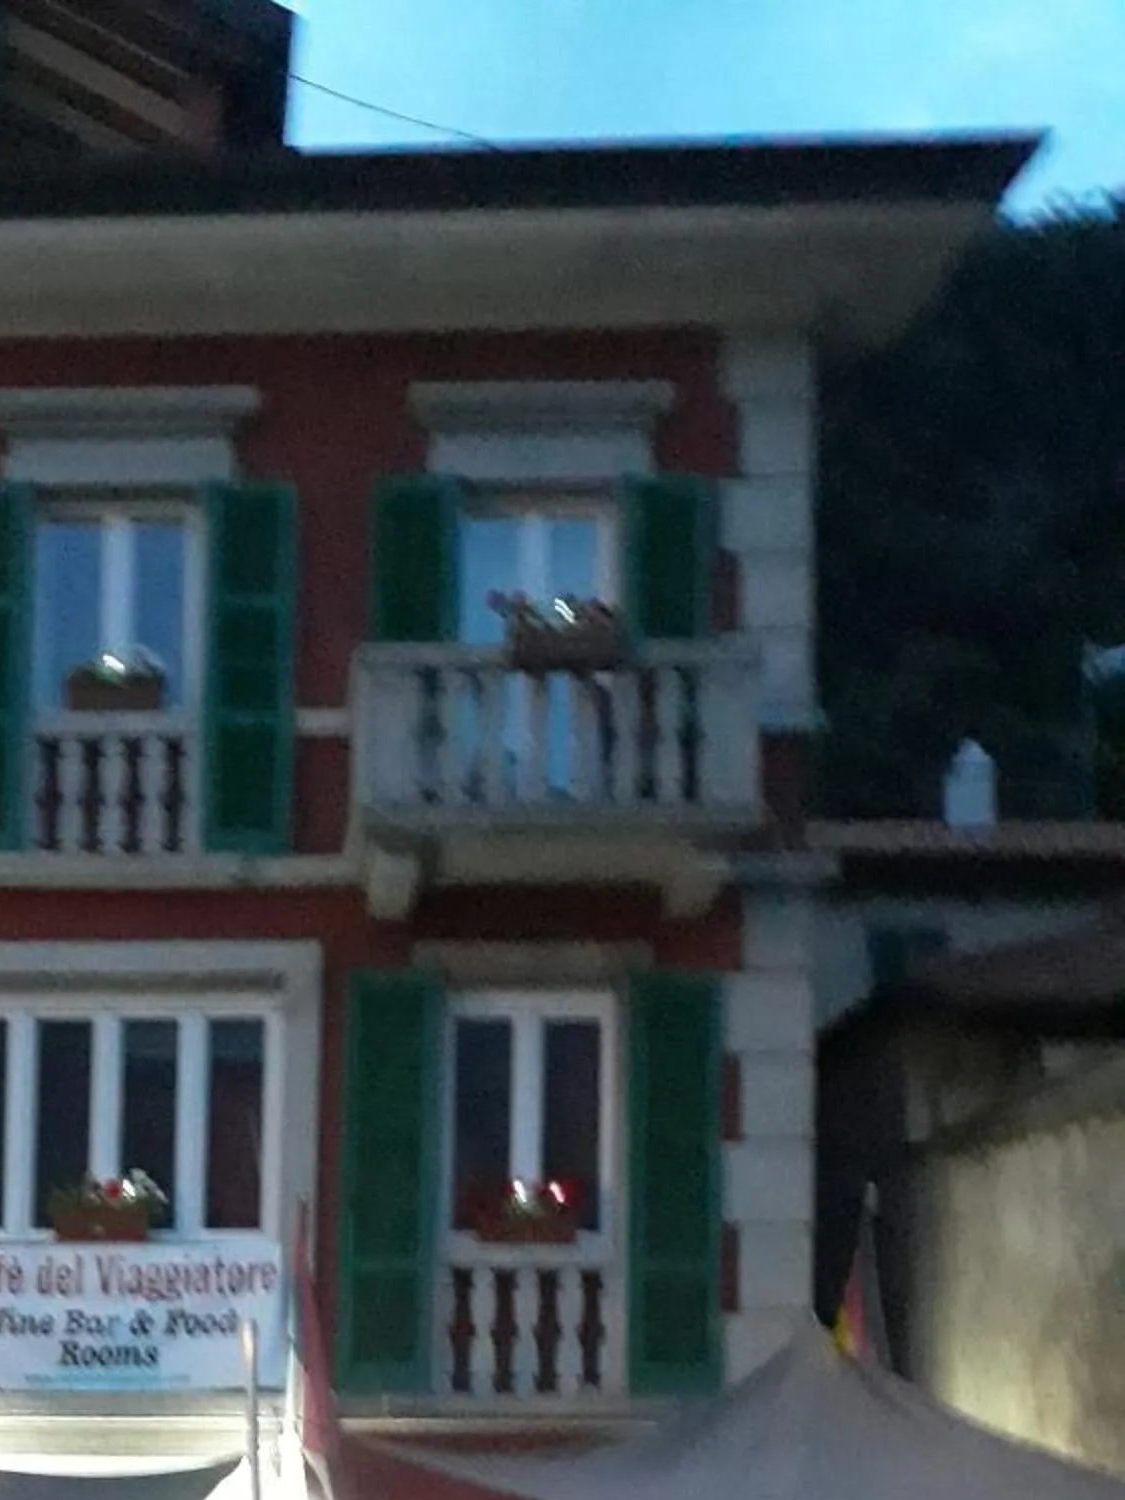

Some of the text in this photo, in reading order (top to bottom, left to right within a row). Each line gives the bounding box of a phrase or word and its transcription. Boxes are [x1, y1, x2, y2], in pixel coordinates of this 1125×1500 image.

[37, 1253, 83, 1296] del
[95, 1253, 277, 1301] Viaggiatore
[64, 1307, 120, 1335] Bar
[129, 1308, 155, 1335] &
[163, 1308, 239, 1336] Food
[58, 1339, 159, 1367] Rooms
